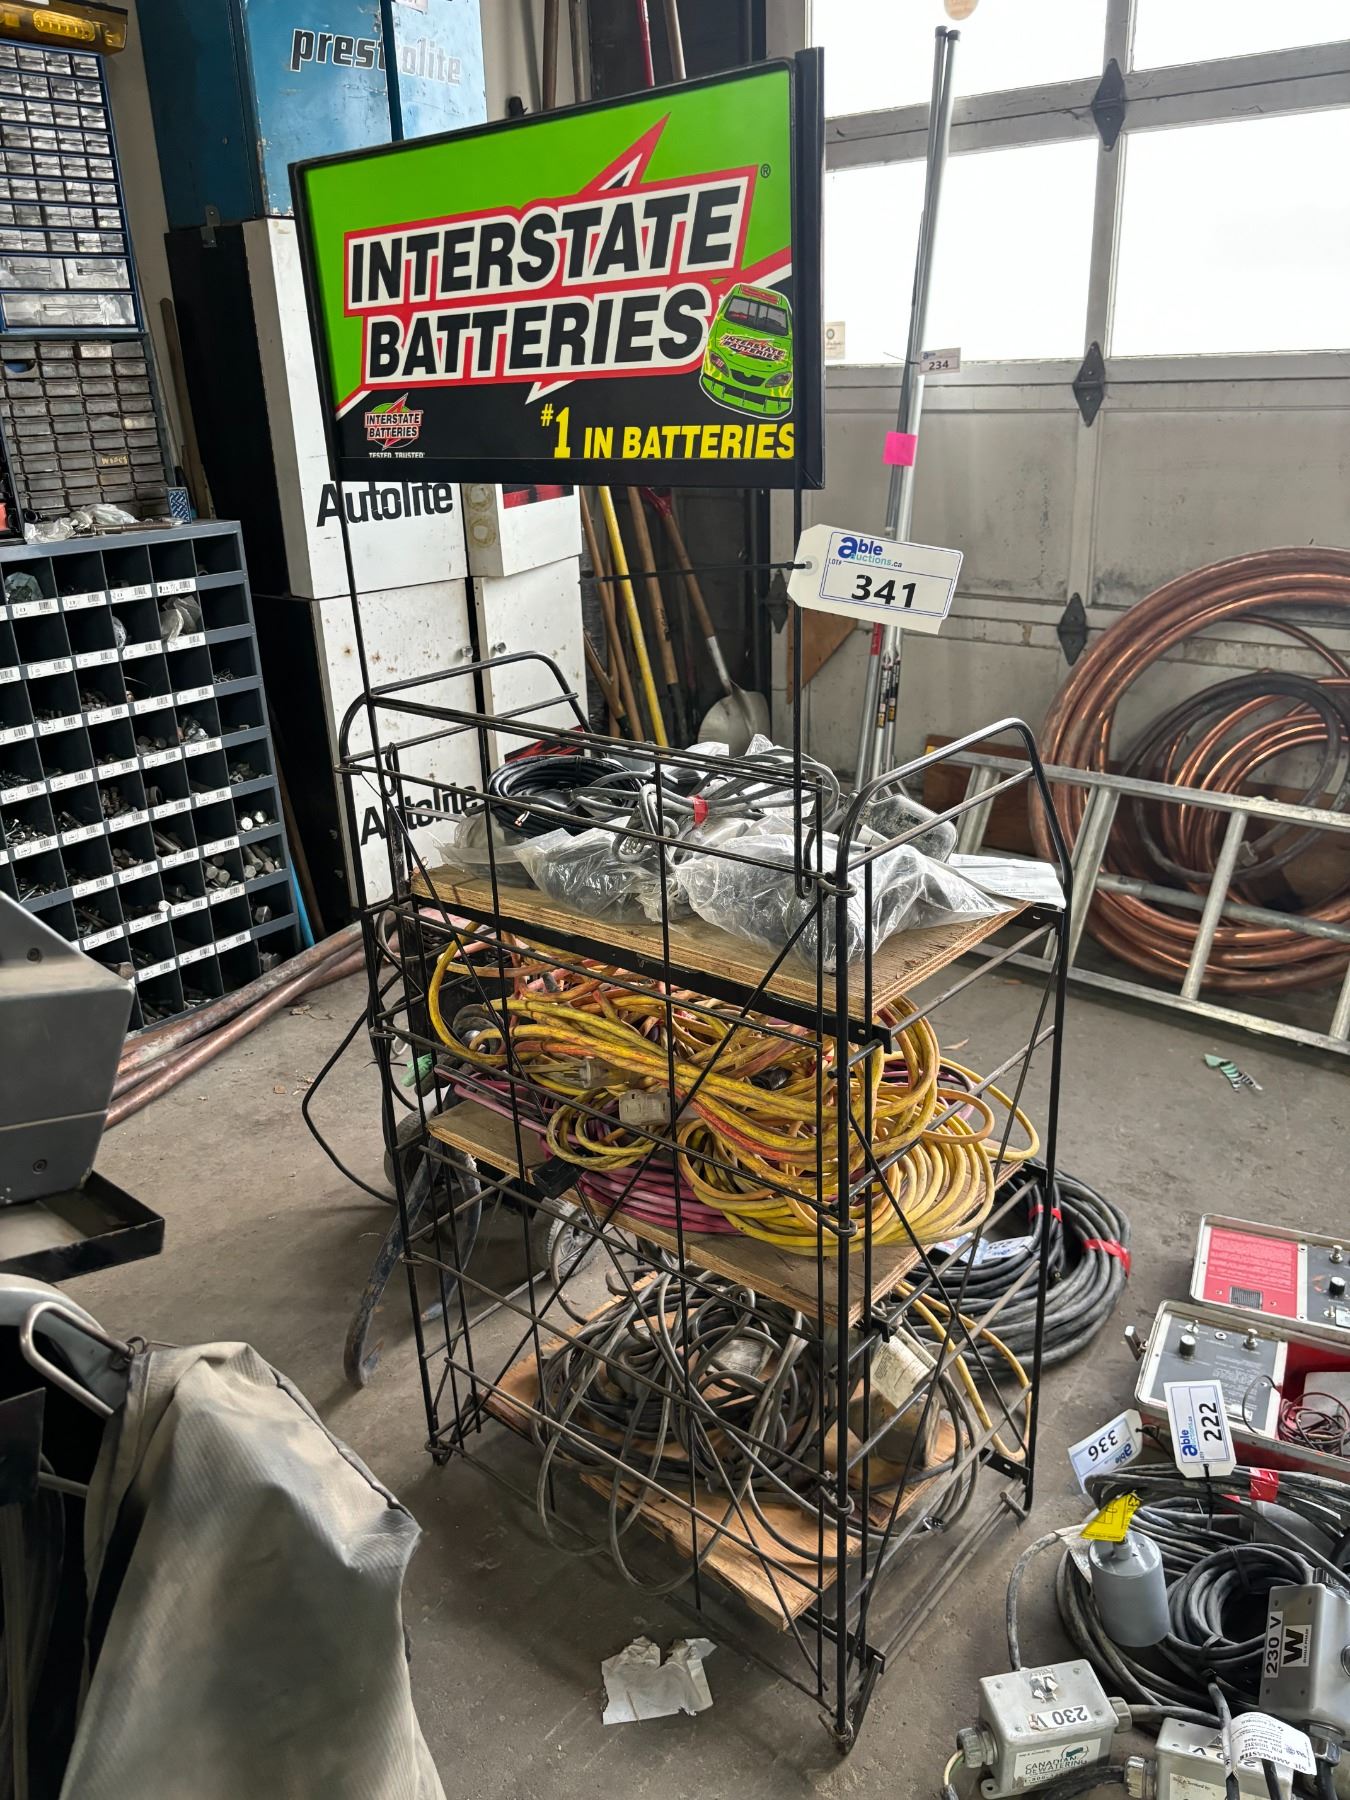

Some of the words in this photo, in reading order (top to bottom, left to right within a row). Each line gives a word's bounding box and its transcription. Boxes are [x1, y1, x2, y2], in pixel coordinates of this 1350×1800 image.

[351, 187, 742, 303] INTERSTATE
[369, 287, 706, 379] BATTERIES
[928, 360, 949, 371] 234
[366, 413, 420, 425] INTERSTATE
[369, 426, 417, 438] BATTERIES
[583, 427, 613, 458] IN
[622, 423, 794, 459] BATTERIES
[316, 481, 453, 528] Autolite
[837, 536, 883, 559] able
[851, 574, 917, 608] 341
[1199, 1402, 1223, 1442] 222
[1088, 1430, 1119, 1462] 336
[1180, 1429, 1198, 1456] able
[1269, 1615, 1282, 1630] V
[1266, 1637, 1280, 1674] 230
[1052, 1706, 1088, 1726] 230
[1025, 1755, 1077, 1770] CANADIAN
